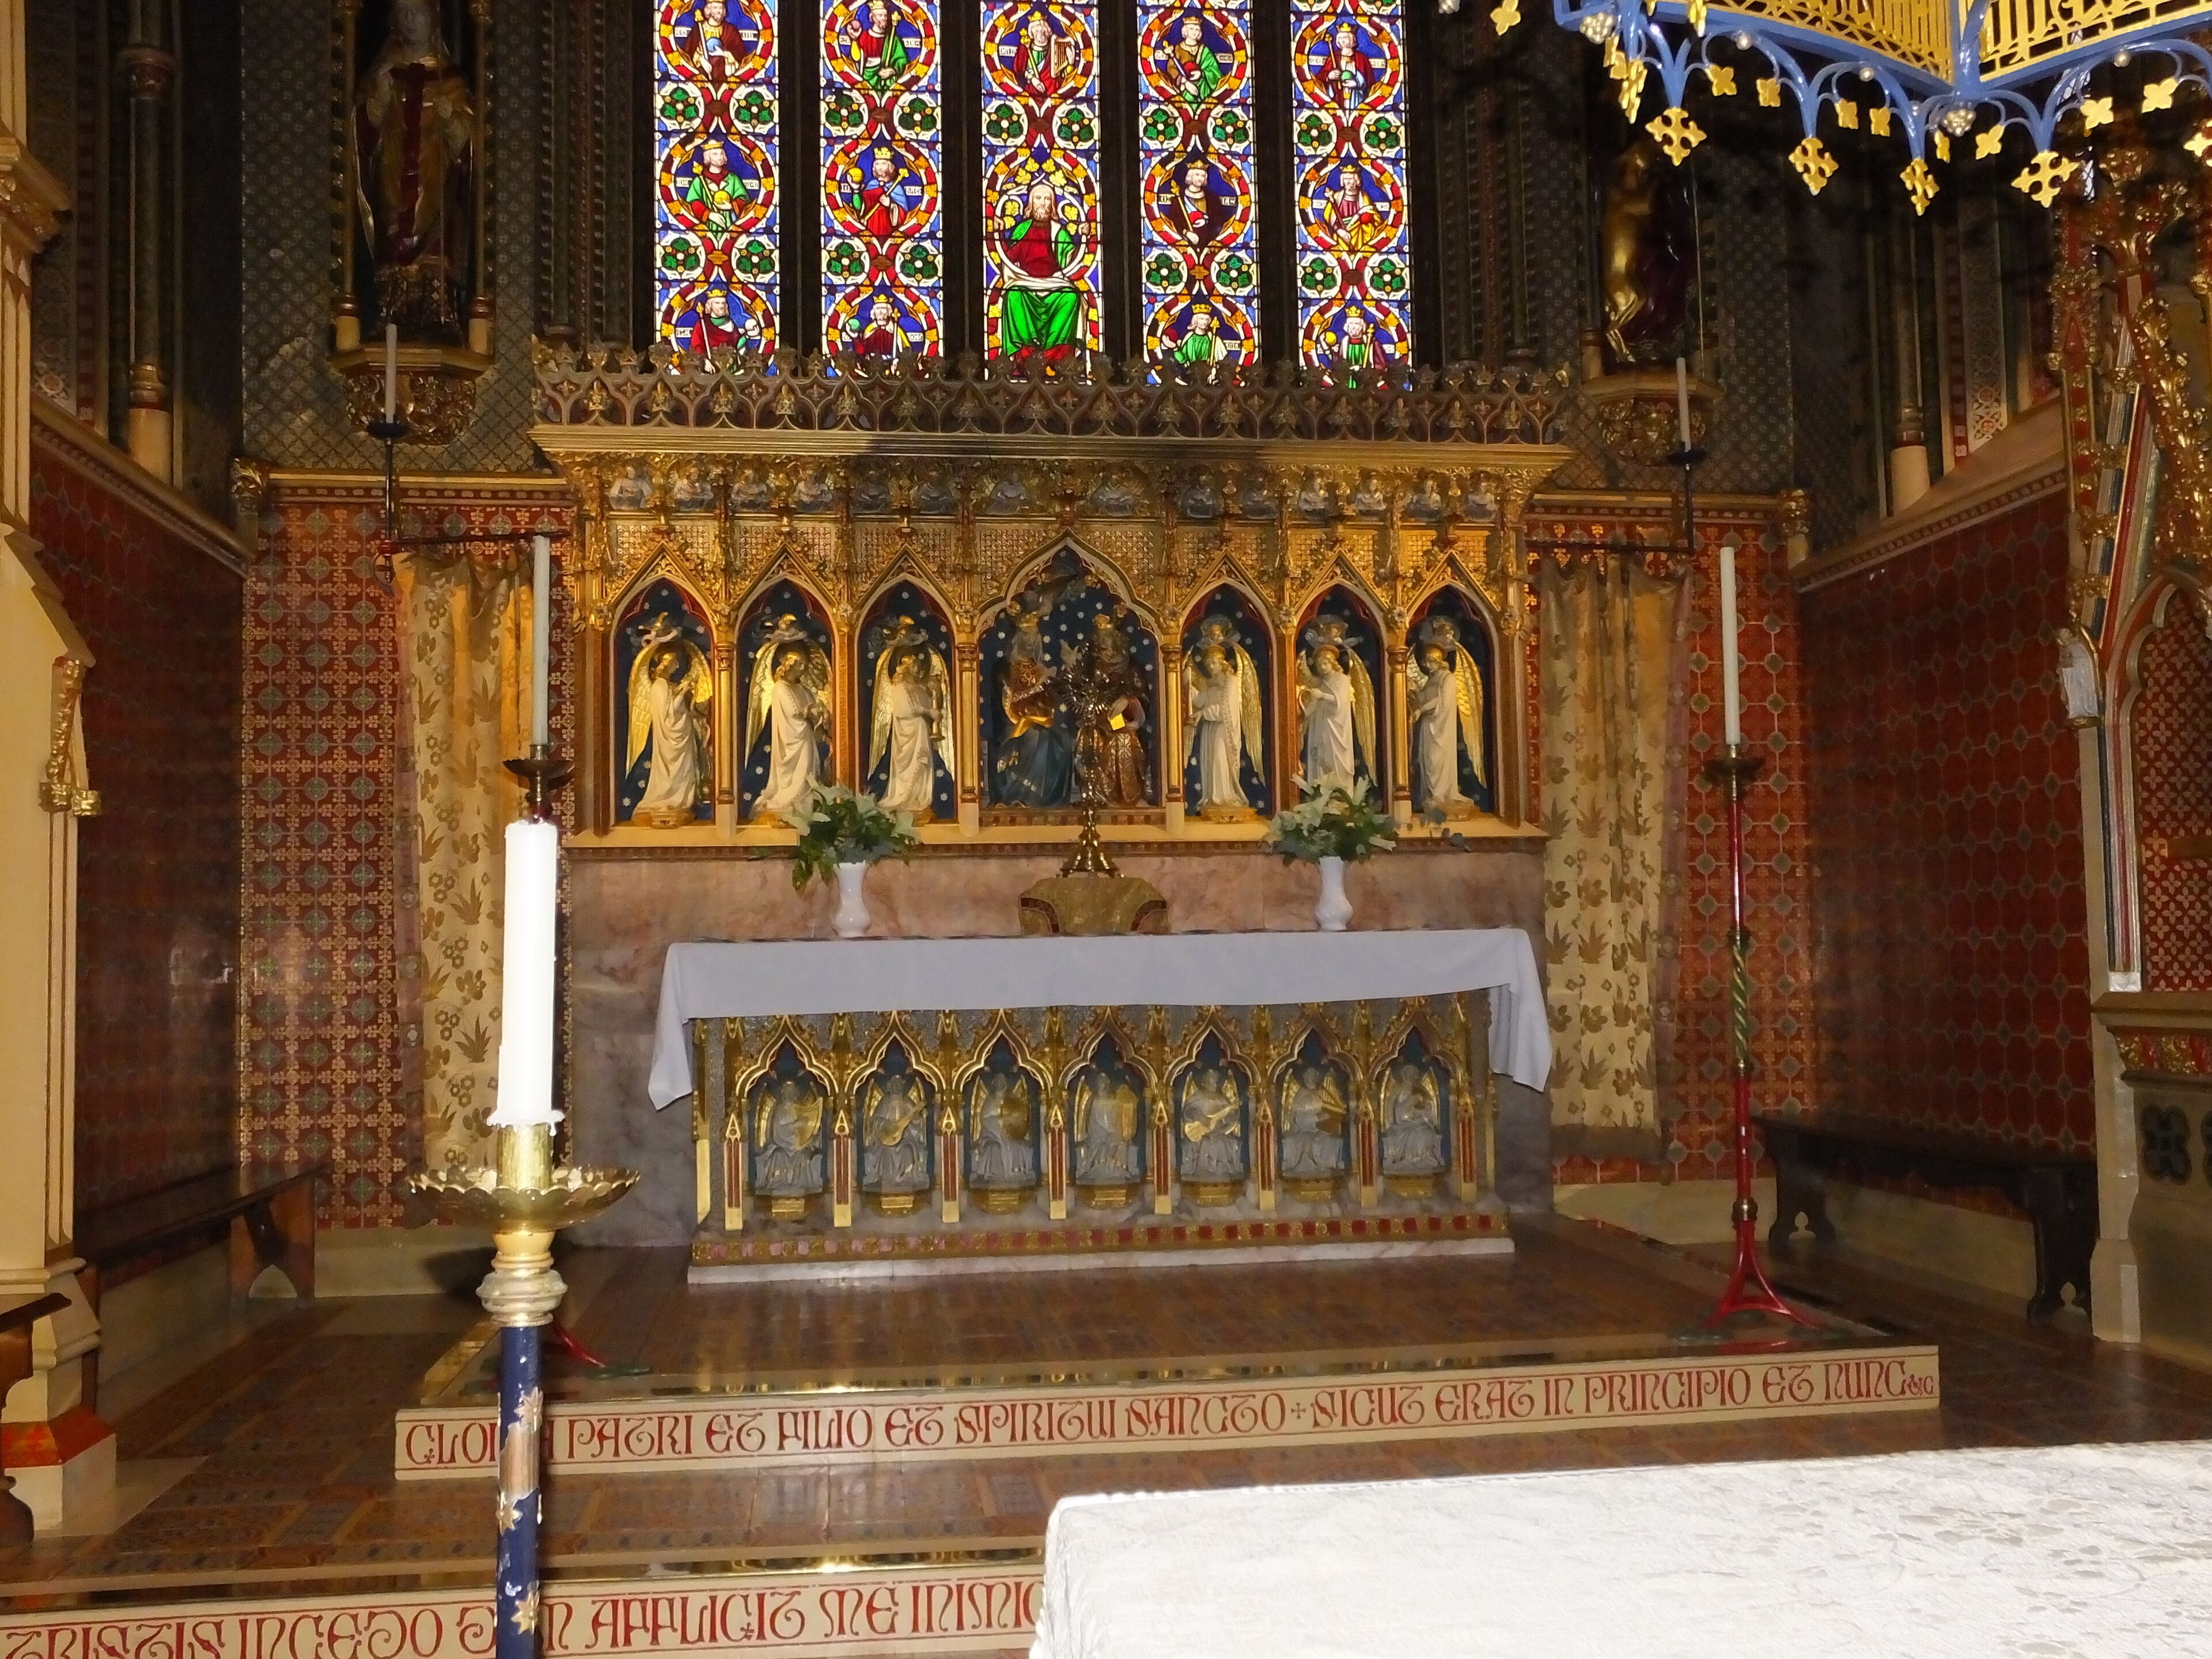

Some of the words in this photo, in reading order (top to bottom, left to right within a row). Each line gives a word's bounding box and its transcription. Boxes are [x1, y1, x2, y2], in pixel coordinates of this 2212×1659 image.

[406, 1423, 554, 1464] GLO
[567, 1415, 693, 1459] PATRI
[706, 1414, 766, 1453] ET
[777, 1407, 873, 1450] FILIO
[884, 1407, 944, 1446] ET
[954, 1399, 1118, 1445] SPIRITUI
[1124, 1392, 1286, 1437] SANCTO
[1310, 1385, 1425, 1428] SICUT
[1435, 1380, 1536, 1422] ERAT
[1543, 1377, 1575, 1416] IN
[1584, 1368, 1752, 1414] PRINCIPIO
[1762, 1364, 1815, 1403] ET
[238, 1608, 444, 1659] INCEDO
[585, 1589, 805, 1649] AFFLIGIT
[819, 1586, 899, 1638] ME
